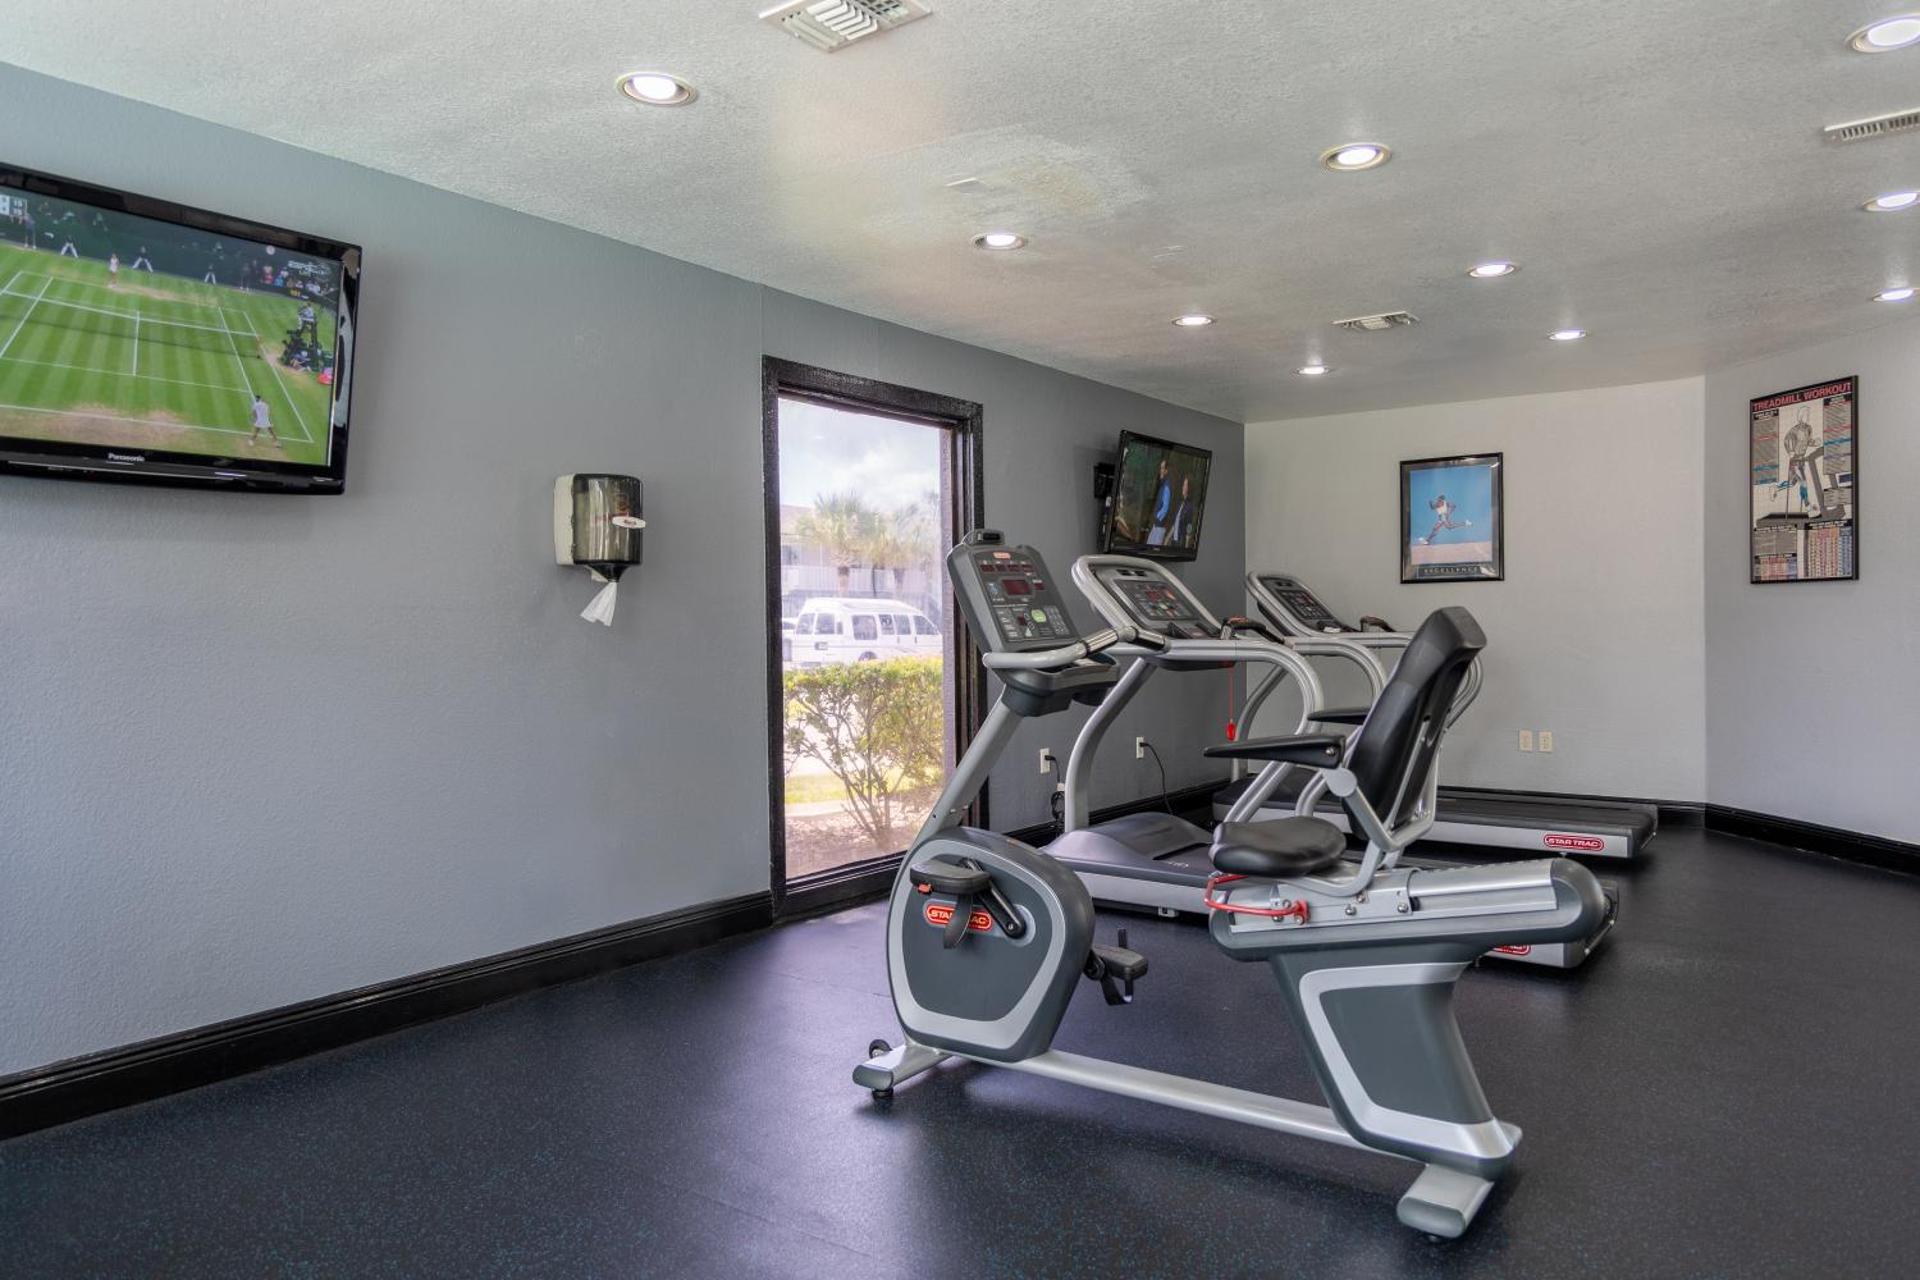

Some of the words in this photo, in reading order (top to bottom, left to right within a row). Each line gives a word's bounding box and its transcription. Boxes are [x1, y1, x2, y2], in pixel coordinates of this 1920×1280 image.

[1754, 393, 1801, 411] TREADMILL
[1804, 382, 1851, 400] WORKOUT
[107, 452, 145, 462] Panasonic
[1573, 839, 1599, 847] TRAC
